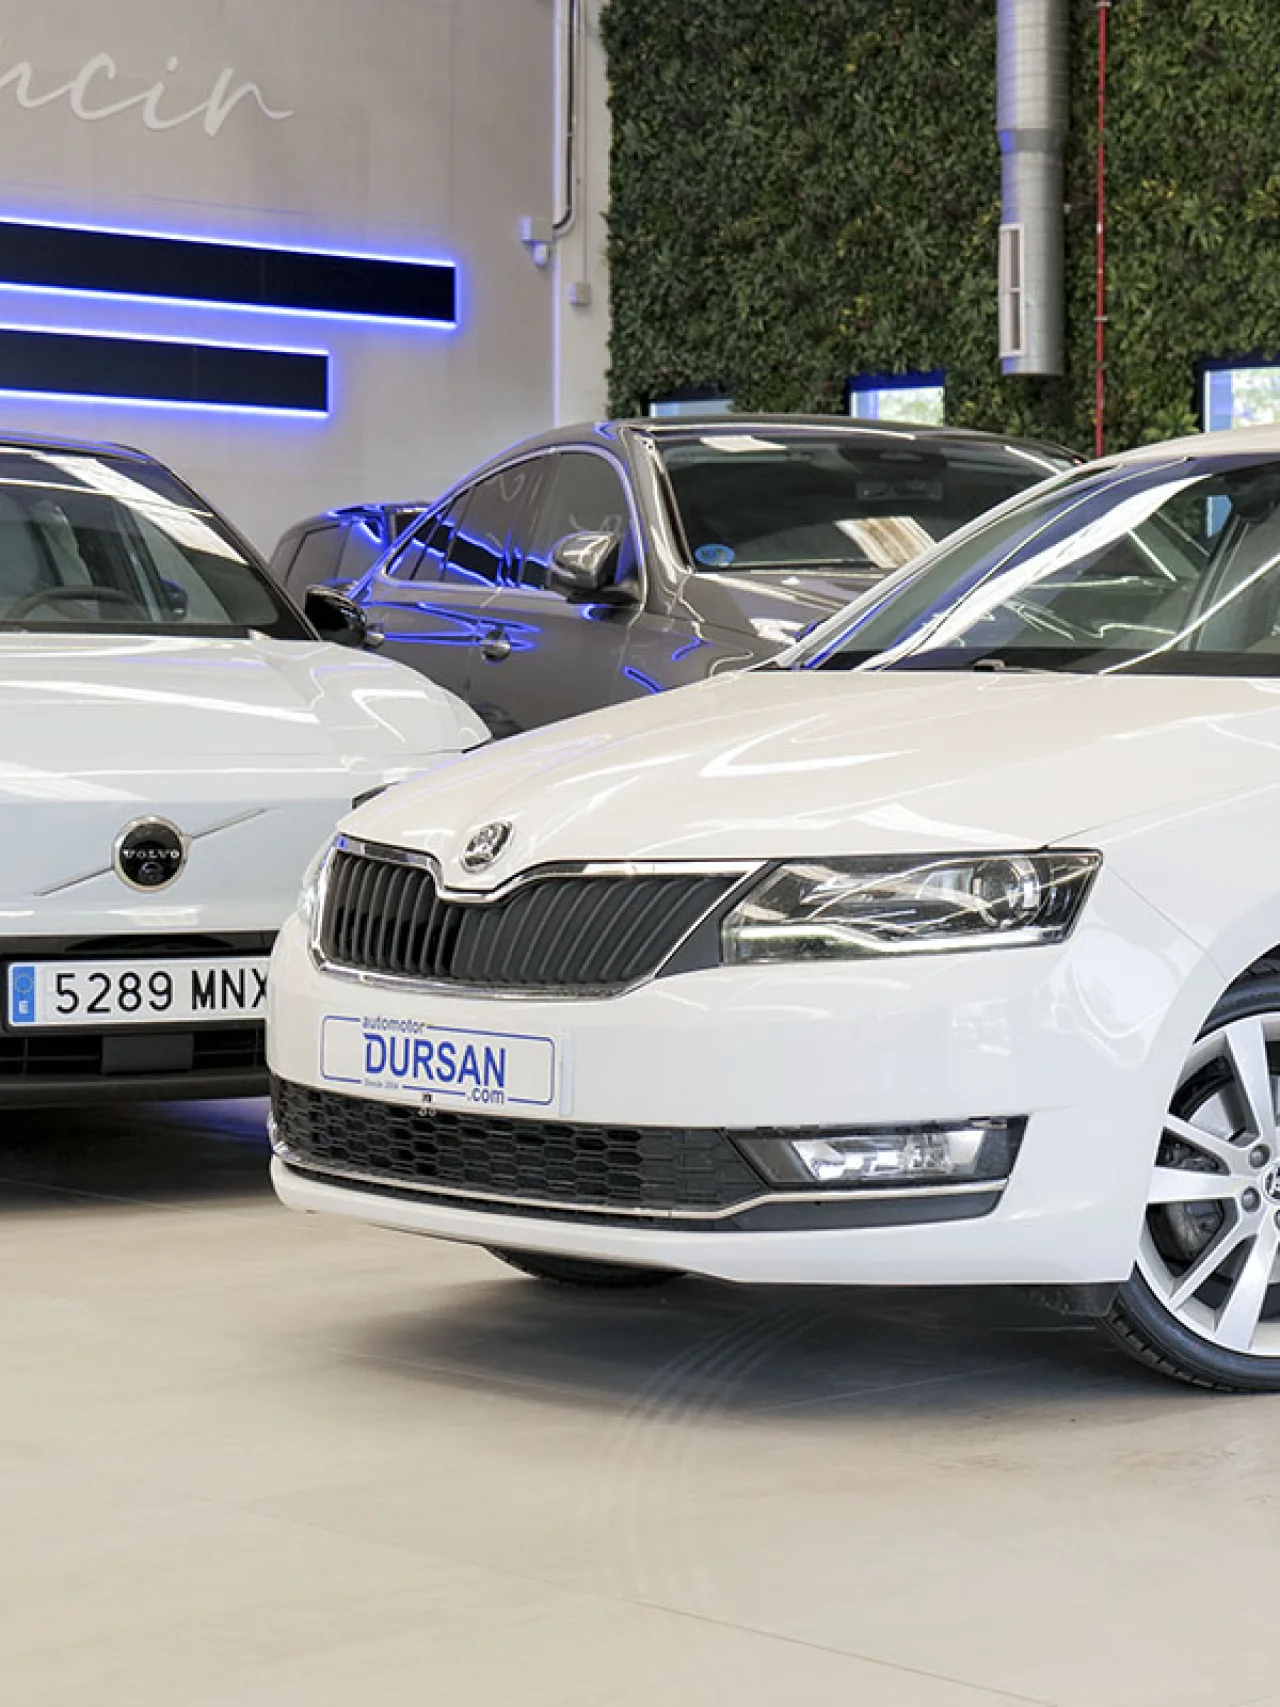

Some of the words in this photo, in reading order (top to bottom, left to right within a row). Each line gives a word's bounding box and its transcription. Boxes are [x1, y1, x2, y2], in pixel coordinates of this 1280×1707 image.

[123, 848, 180, 859] VOLVO
[55, 971, 174, 1014] 5289
[191, 968, 267, 1010] MNX
[18, 1000, 29, 1015] E
[362, 1016, 426, 1034] automotor
[363, 1032, 505, 1088] DURSAN
[466, 1087, 504, 1105] .com
